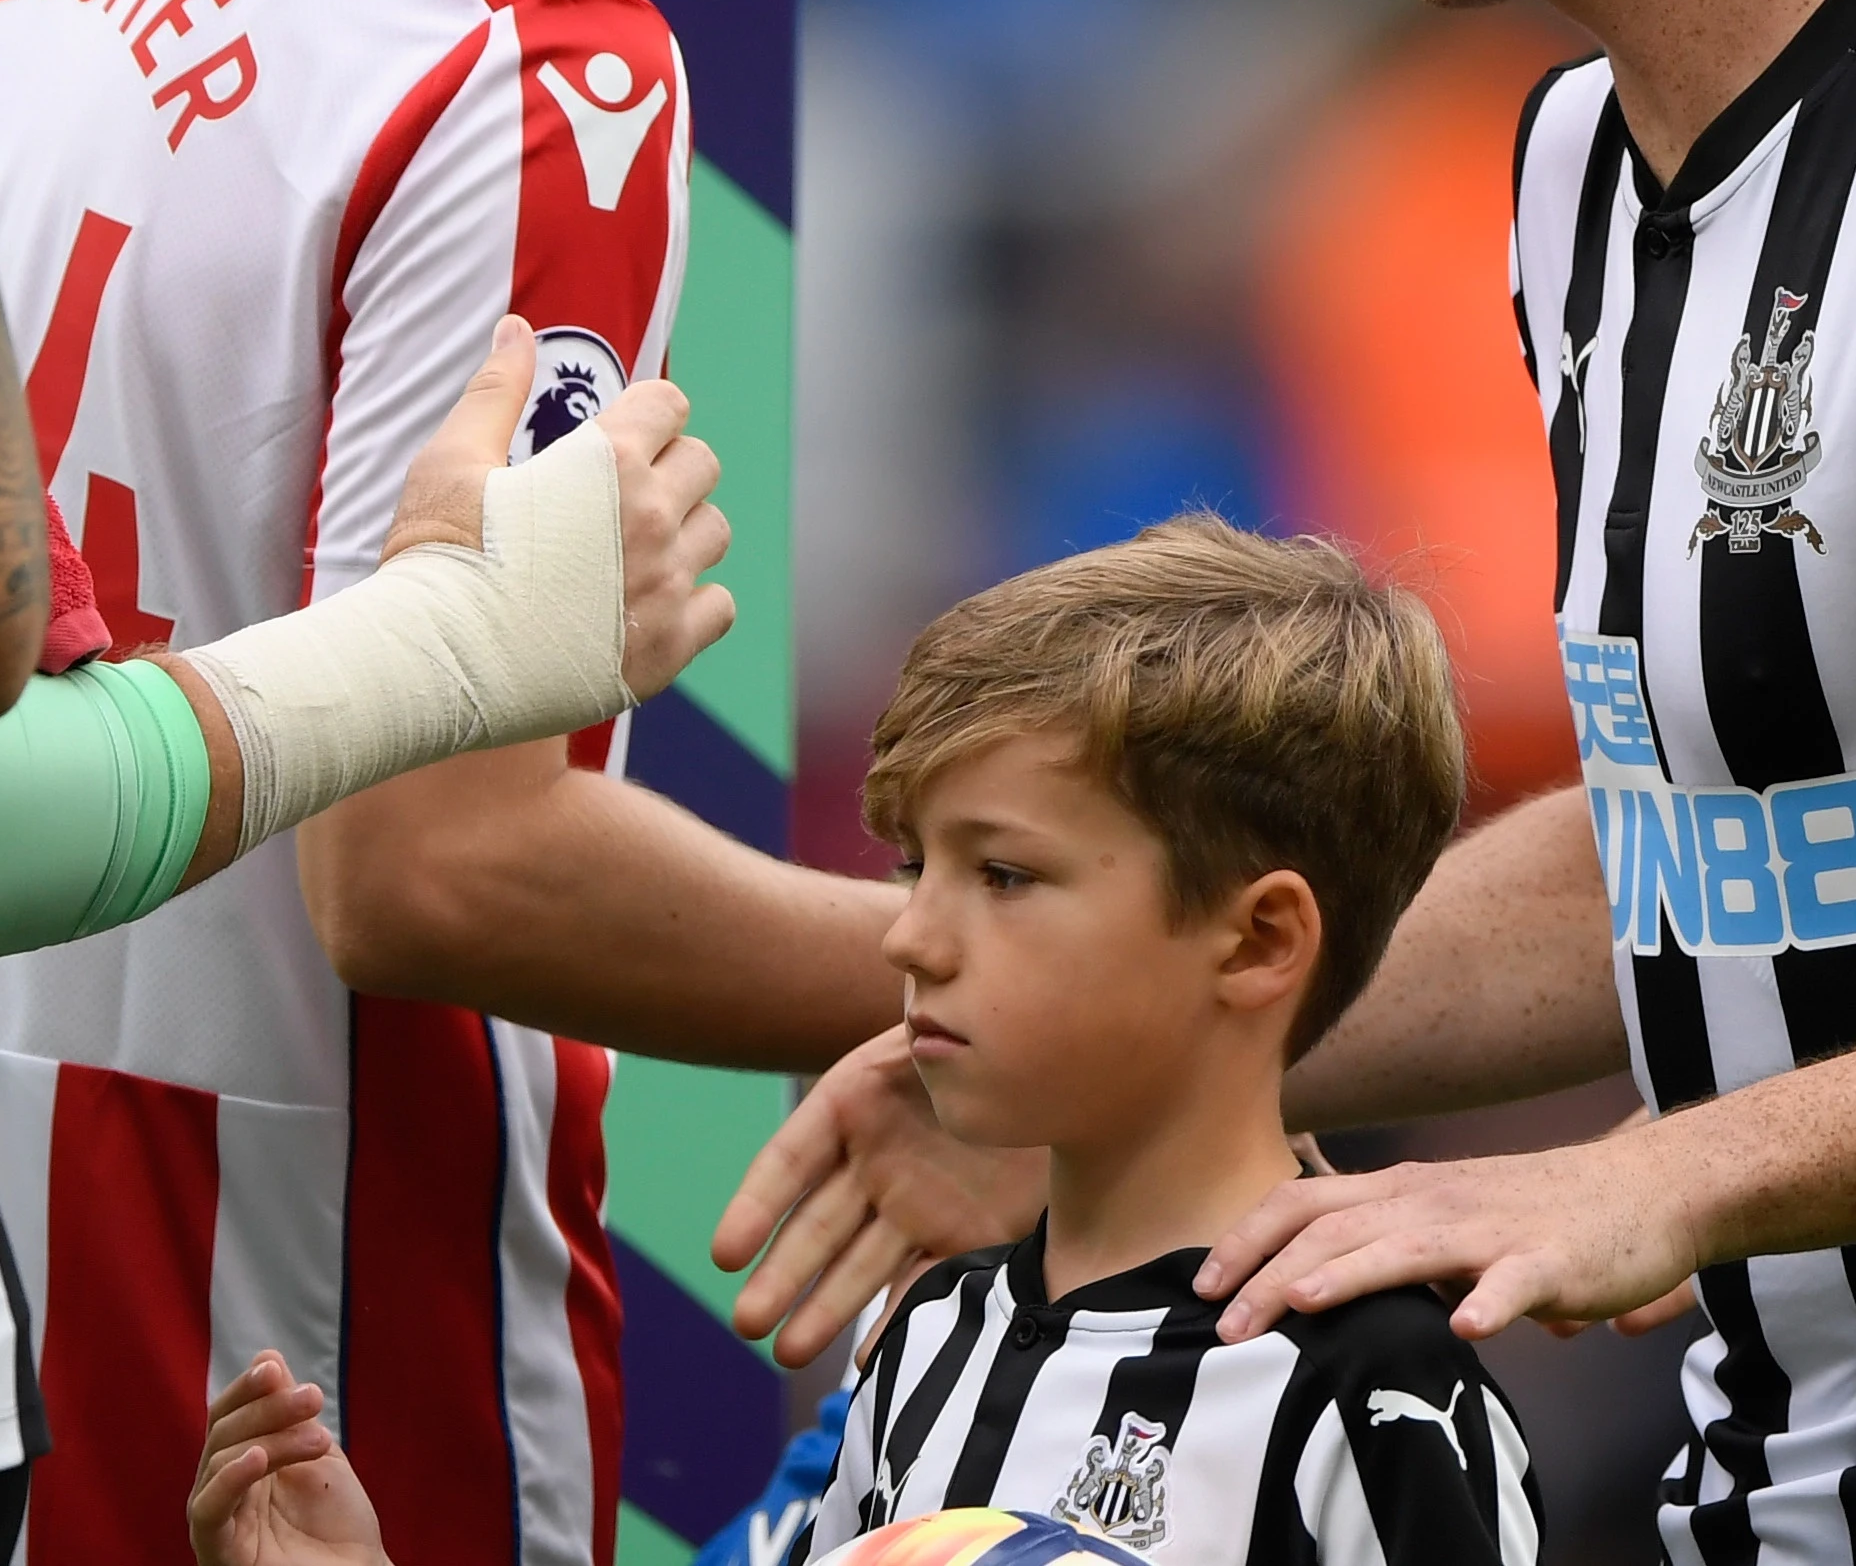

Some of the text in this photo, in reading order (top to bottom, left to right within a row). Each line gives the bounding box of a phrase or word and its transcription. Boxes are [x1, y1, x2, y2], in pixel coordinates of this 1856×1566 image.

[1705, 469, 1802, 497] NEWCASTLE UNITED
[1731, 511, 1762, 535] 125
